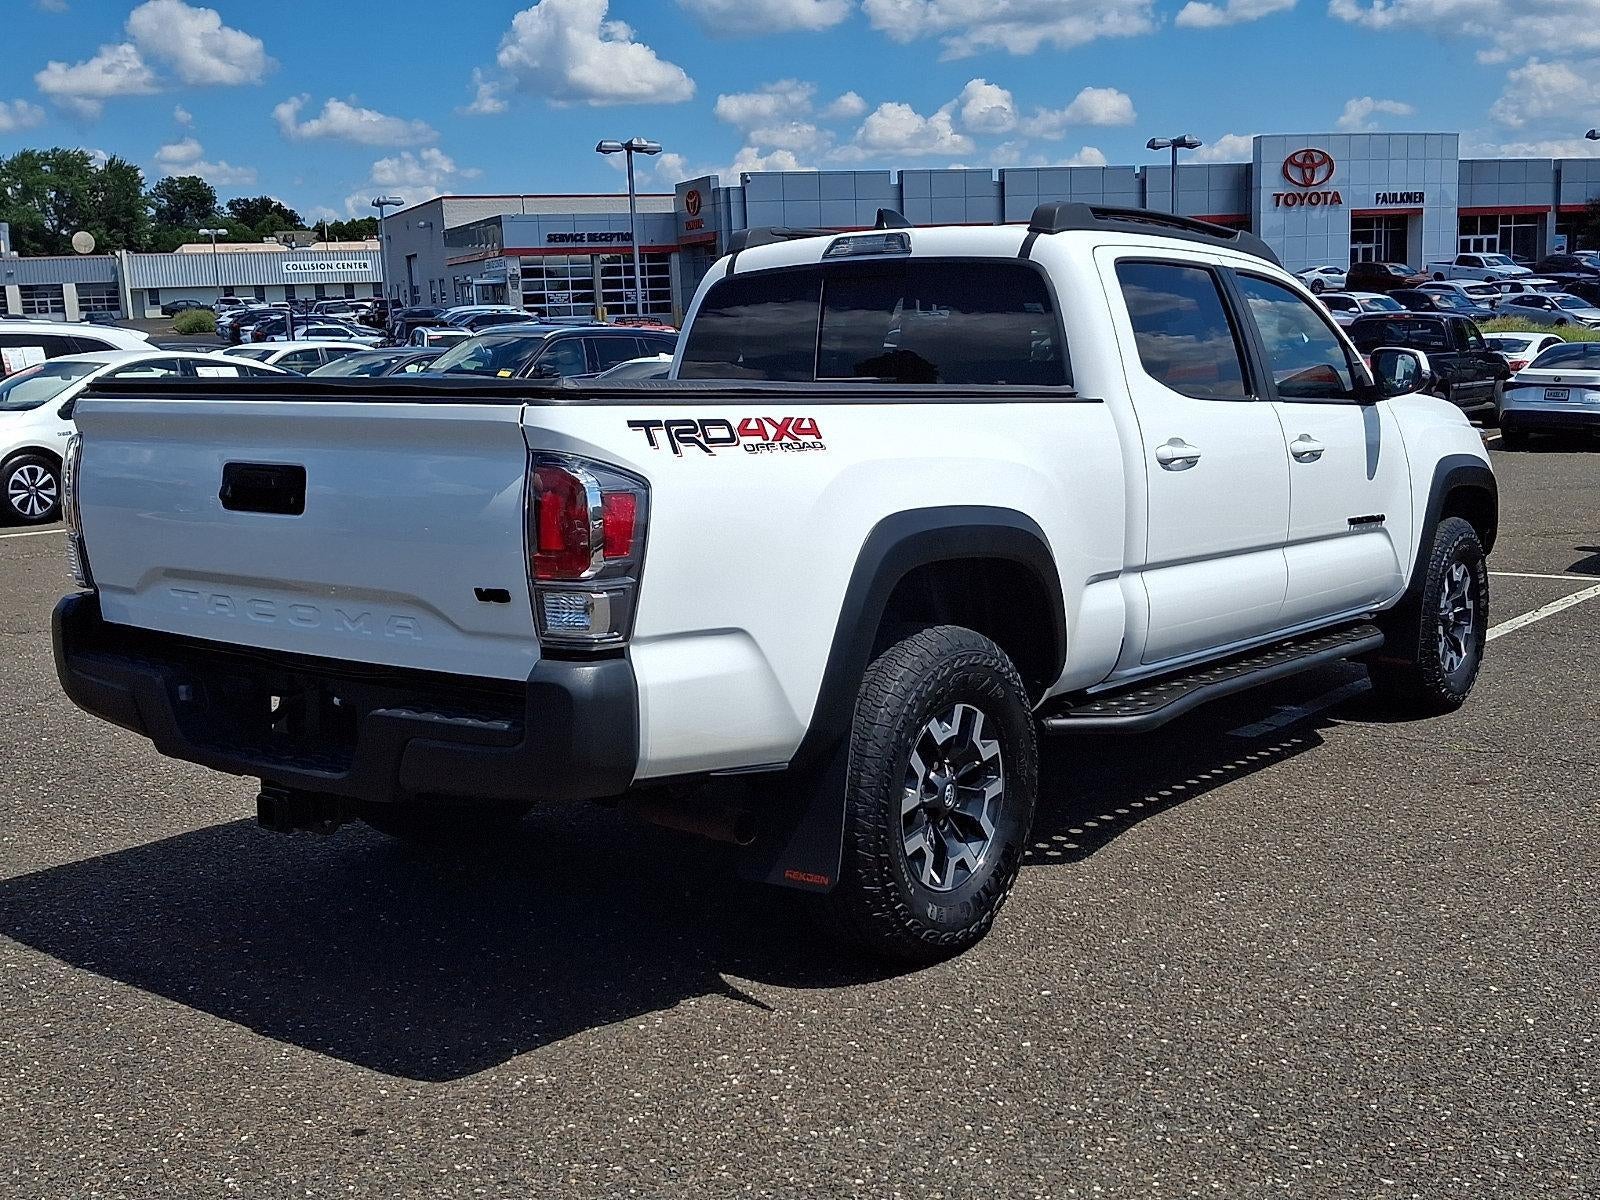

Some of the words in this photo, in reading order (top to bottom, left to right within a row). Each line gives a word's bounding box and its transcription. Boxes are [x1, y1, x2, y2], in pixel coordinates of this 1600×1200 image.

[1273, 191, 1343, 207] TOYOTA
[1375, 192, 1425, 205] FAULKNER
[547, 232, 585, 243] SERVICE
[285, 262, 333, 271] COLLISION
[335, 261, 369, 270] CENTER
[627, 419, 740, 457] TRD
[743, 442, 779, 454] OFF
[779, 441, 826, 453] ROAD
[168, 587, 424, 641] TACOMA
